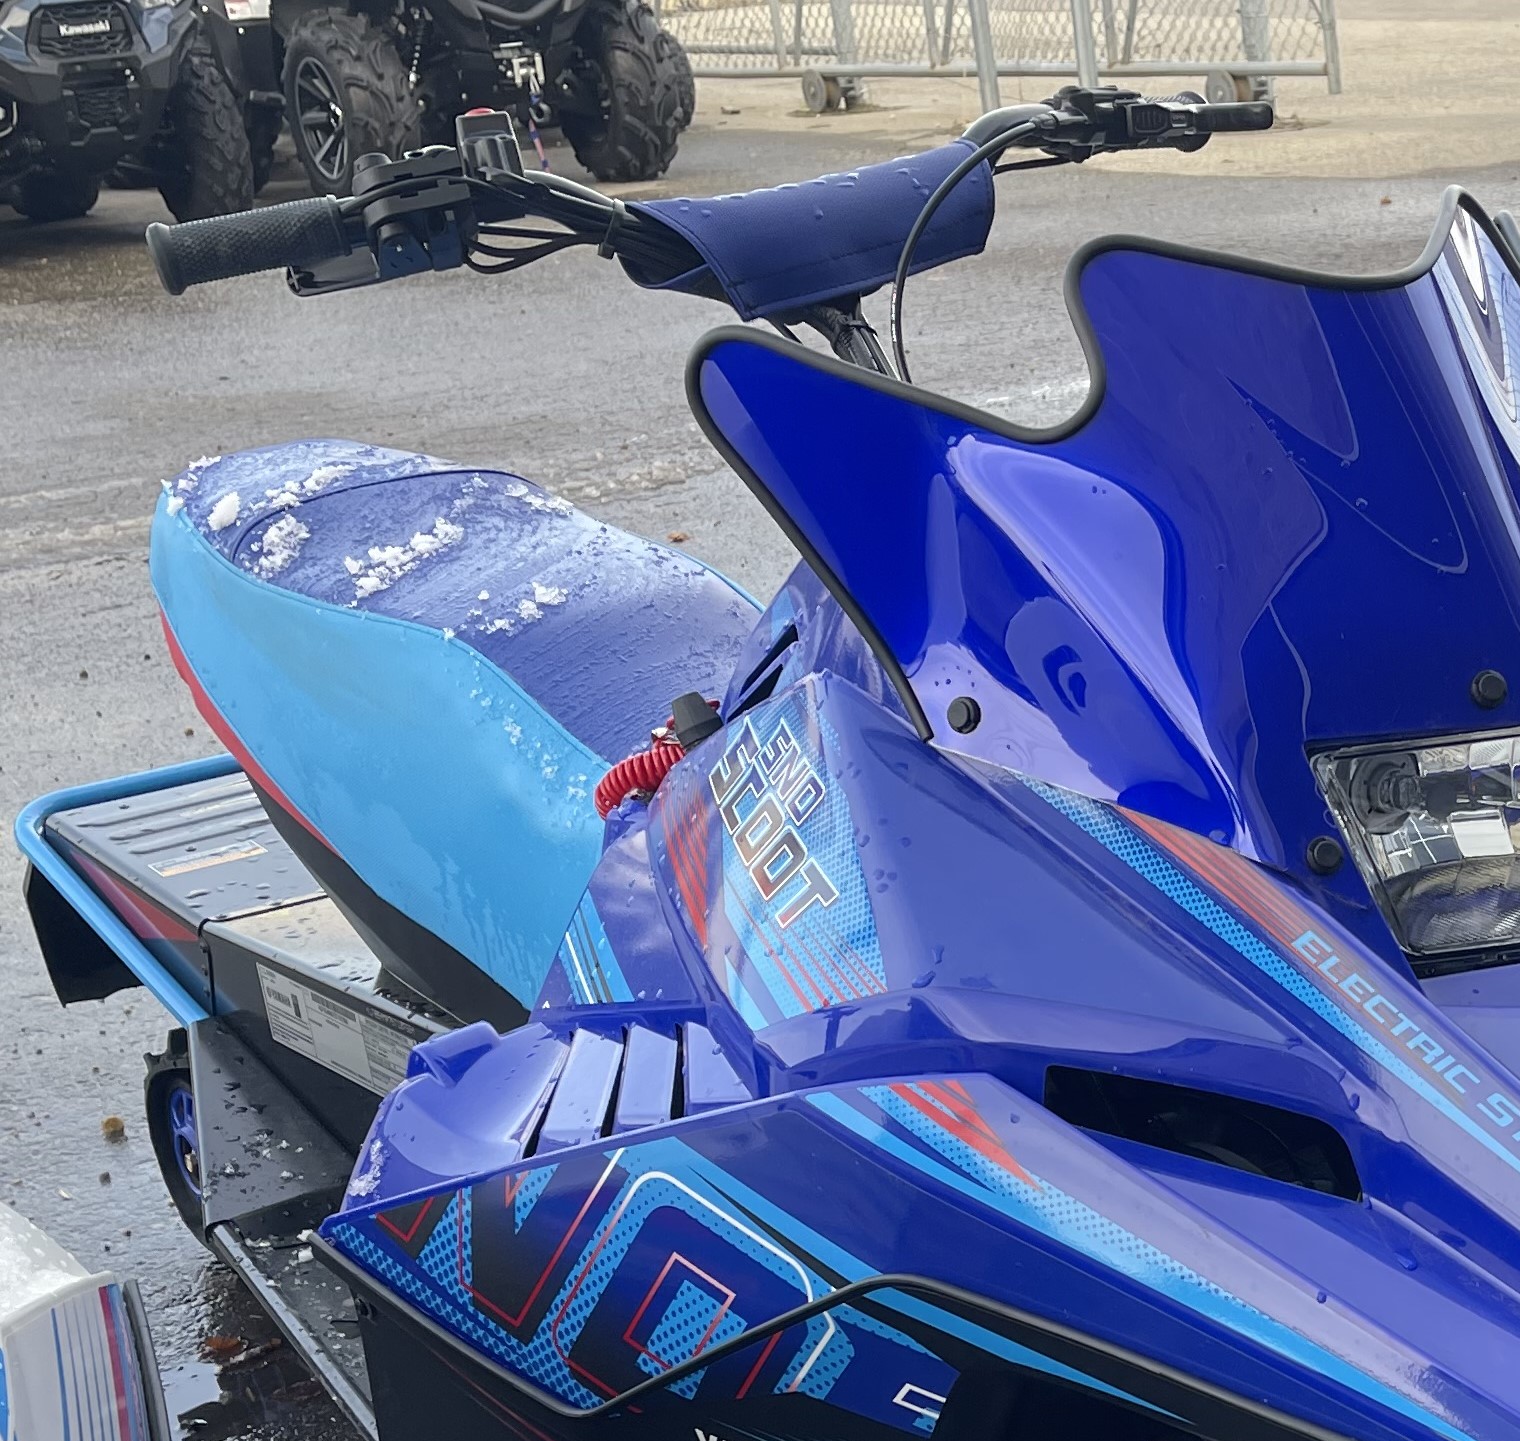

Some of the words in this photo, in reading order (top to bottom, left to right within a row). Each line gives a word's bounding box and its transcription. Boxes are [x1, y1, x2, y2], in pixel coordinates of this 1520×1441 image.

[59, 19, 110, 37] Kawasaki
[708, 714, 840, 929] SCOOT
[757, 716, 826, 827] SNO
[1291, 929, 1481, 1094] ELECTRIC
